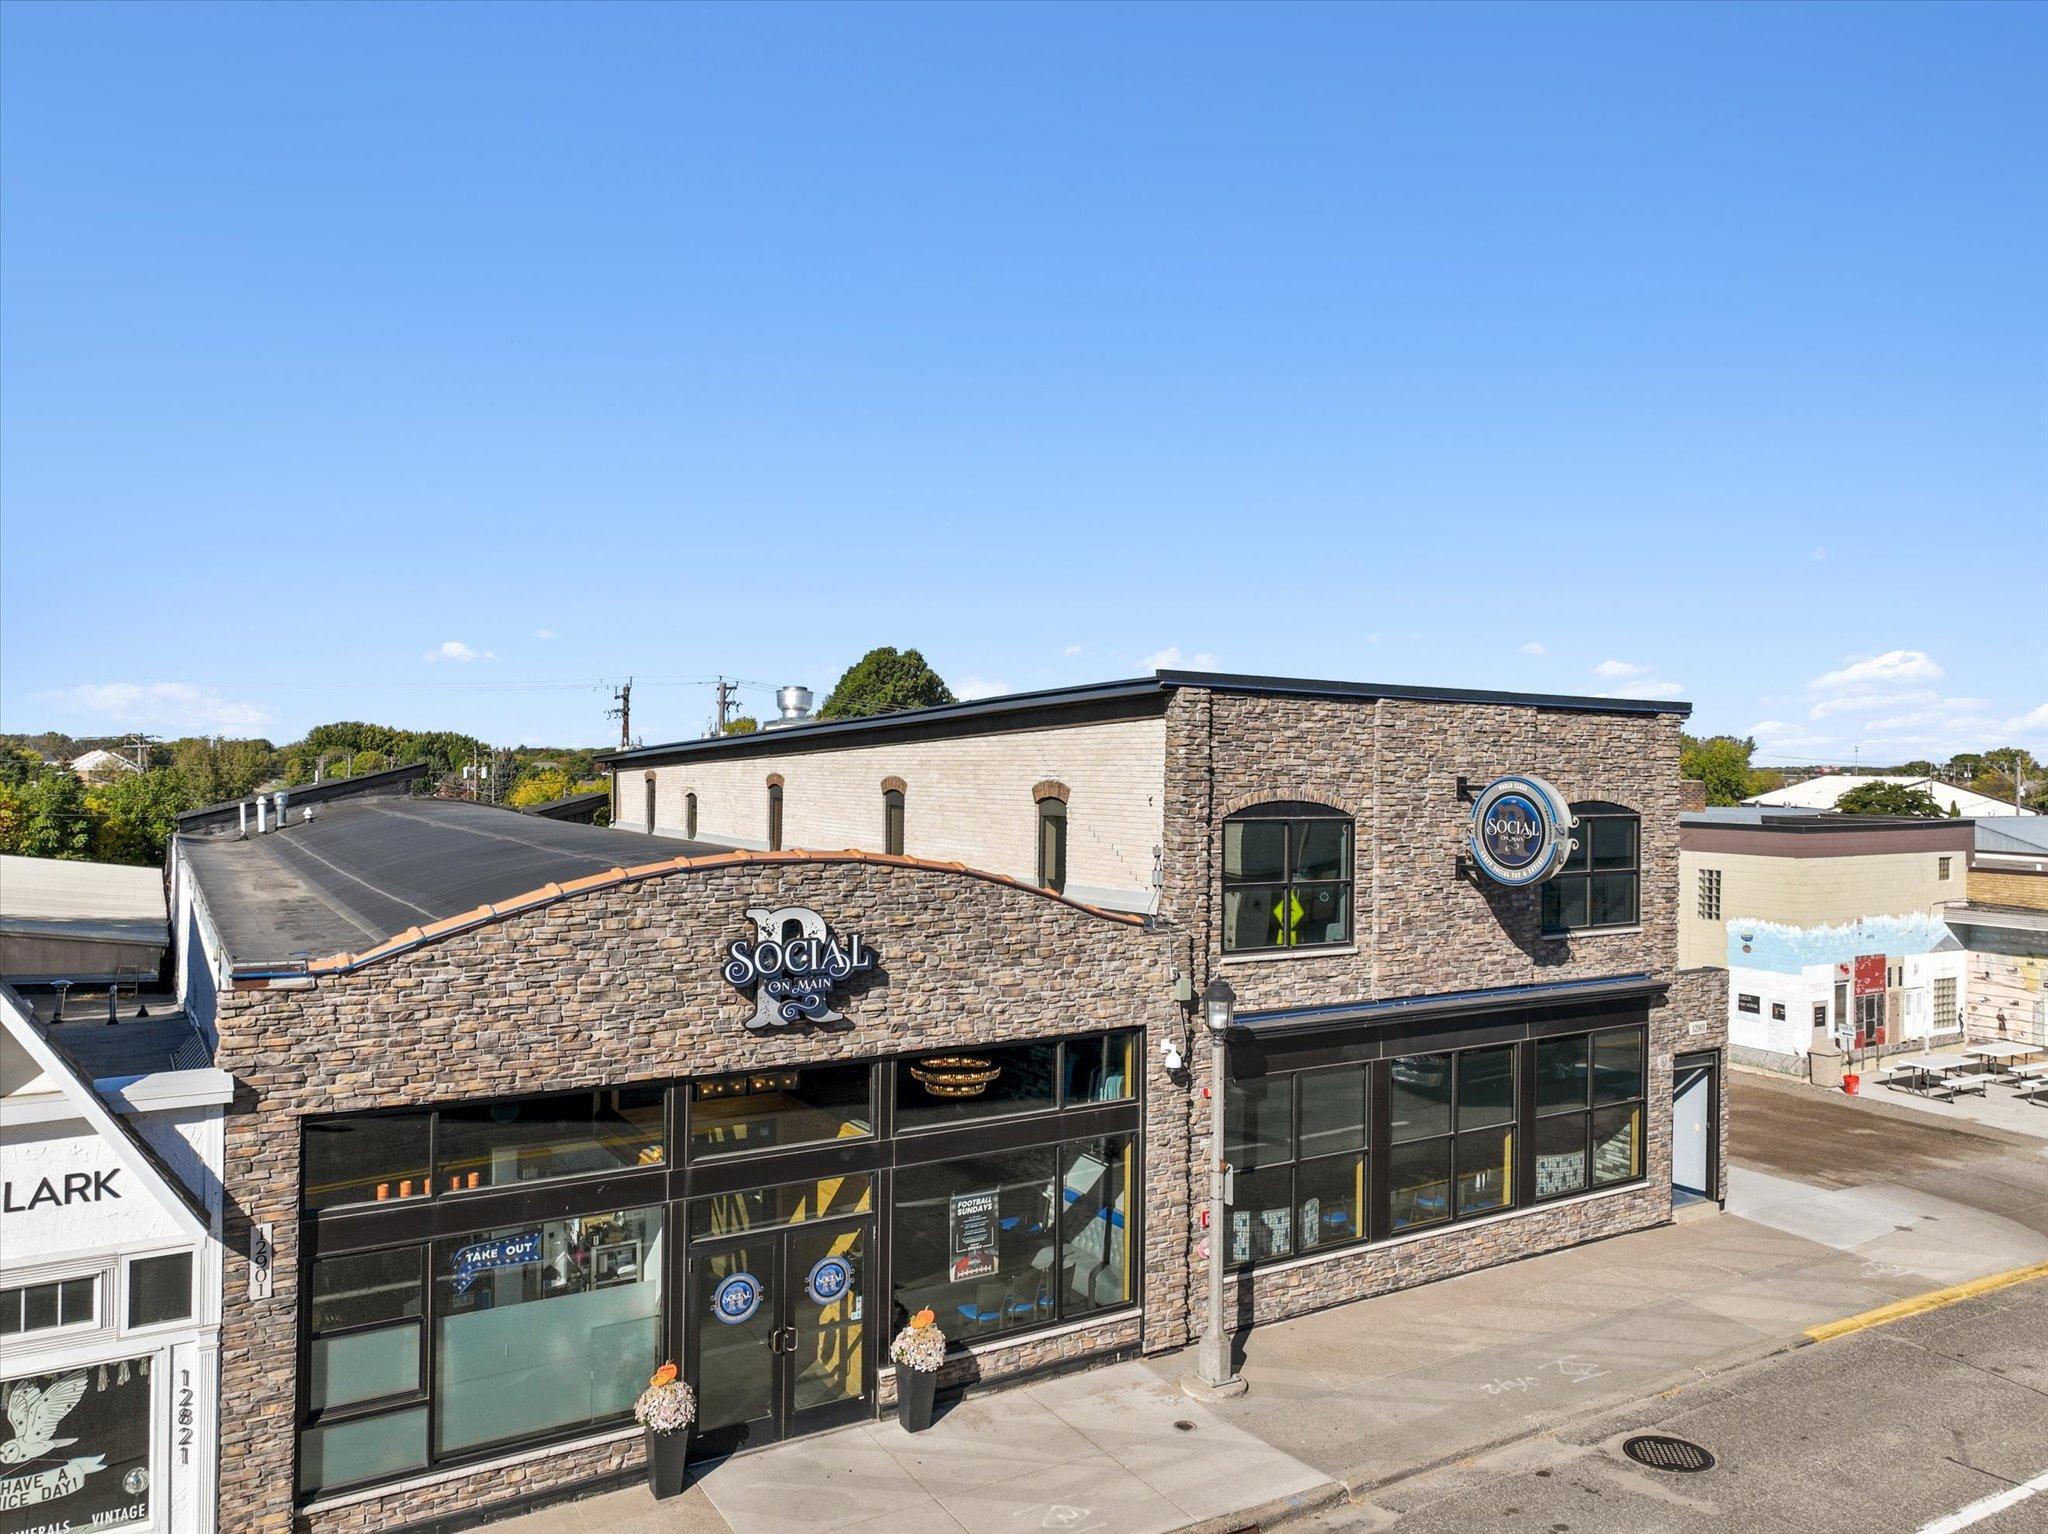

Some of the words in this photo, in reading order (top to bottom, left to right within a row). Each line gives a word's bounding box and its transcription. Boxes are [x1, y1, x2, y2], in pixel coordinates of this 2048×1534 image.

[1486, 818, 1540, 839] SOCIAL
[1500, 834, 1509, 842] ON
[724, 934, 869, 984] SOCIAL
[746, 906, 844, 1029] R
[768, 981, 790, 993] ON
[791, 977, 832, 994] MAIN
[3, 1168, 122, 1213] LARK
[957, 1197, 992, 1209] FOOTBALL
[957, 1203, 993, 1216] SUNDAYS
[254, 1226, 268, 1298] 12901
[465, 1248, 498, 1263] TAKE
[506, 1242, 533, 1256] OUT
[177, 1369, 194, 1465] 12821
[0, 1491, 30, 1510] ICE
[41, 1477, 78, 1501] DAY!
[1, 1473, 44, 1495] HAVE
[58, 1467, 69, 1482] A
[91, 1503, 147, 1527] VINTAGE
